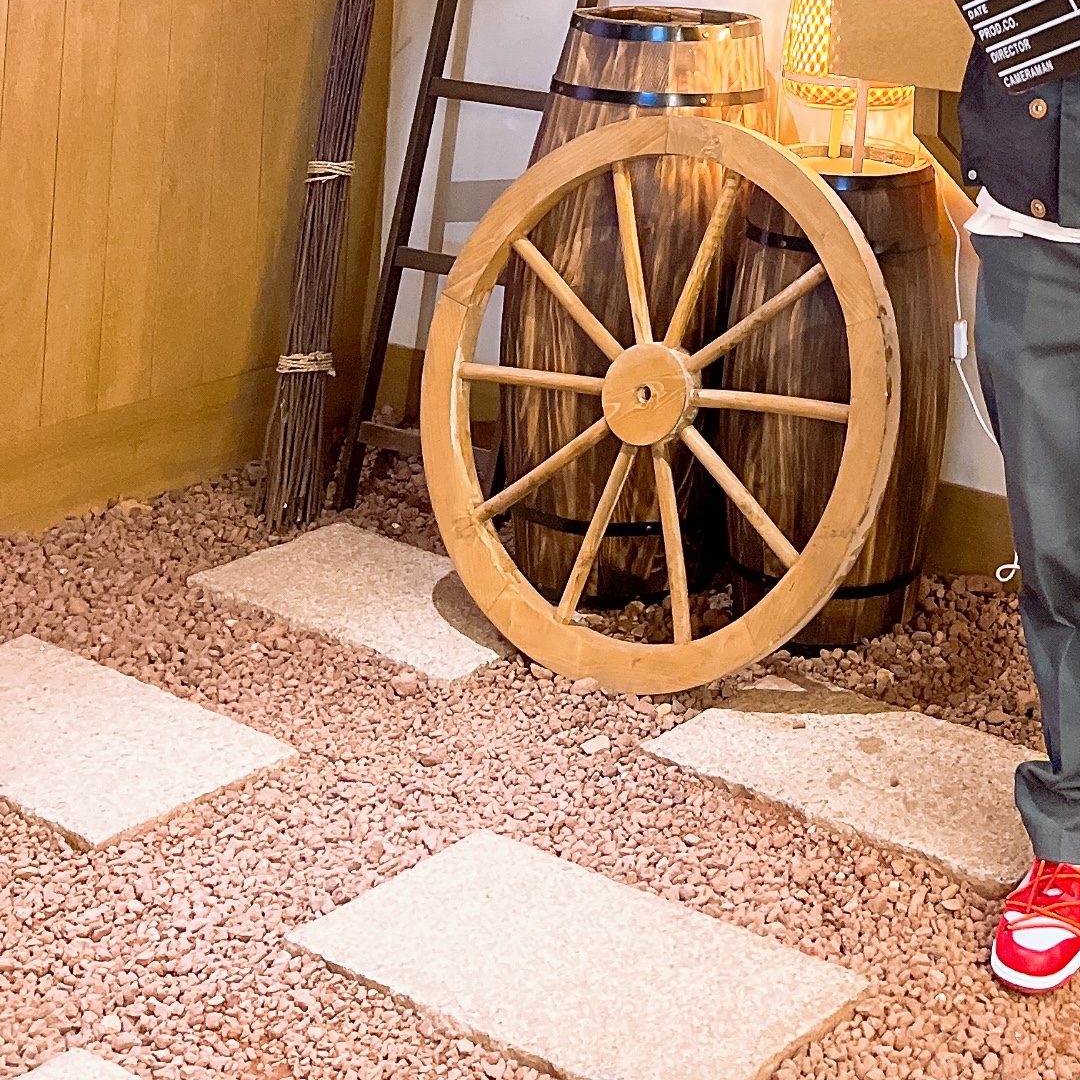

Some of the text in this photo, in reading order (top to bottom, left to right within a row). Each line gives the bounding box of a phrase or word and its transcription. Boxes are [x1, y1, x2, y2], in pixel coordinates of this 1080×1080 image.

[967, 3, 989, 21] DATE
[989, 38, 1032, 64] DIRECTOR
[1003, 59, 1054, 88] CAMERAMAN
